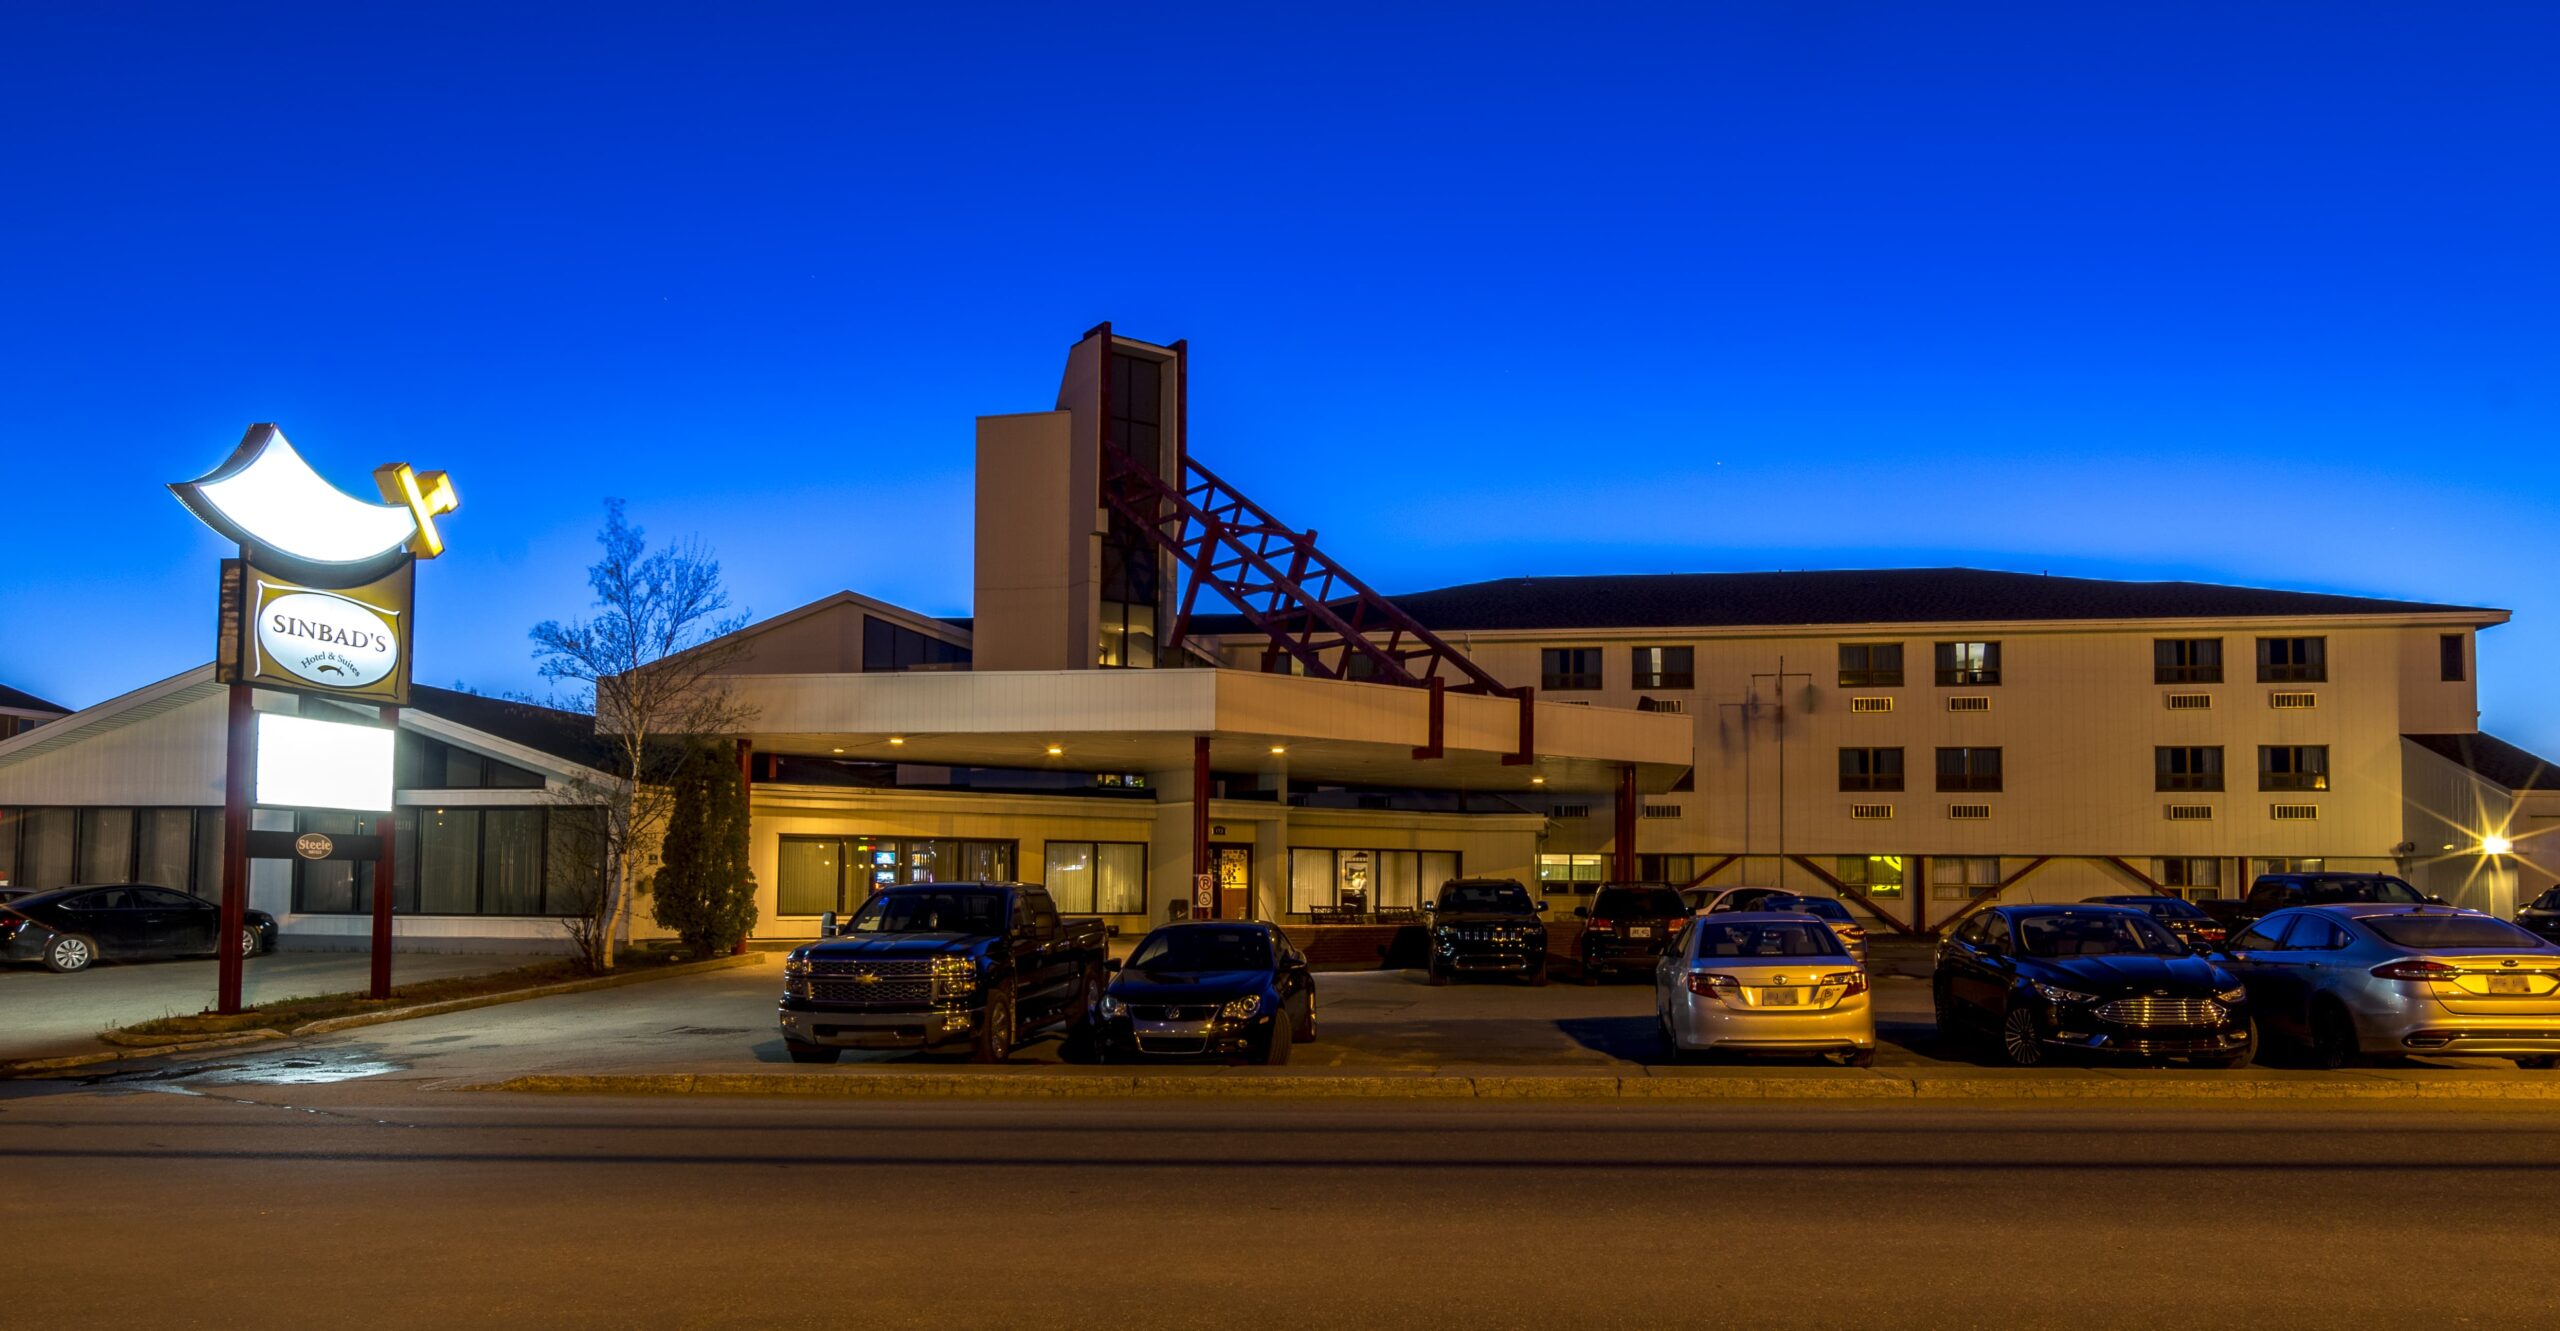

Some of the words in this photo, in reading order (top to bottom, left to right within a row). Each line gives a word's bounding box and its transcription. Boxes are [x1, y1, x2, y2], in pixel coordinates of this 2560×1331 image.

[272, 614, 386, 652] SINBAD'S
[301, 651, 326, 669] Hotel
[328, 652, 336, 661] &
[337, 654, 361, 677] Suites
[298, 839, 331, 850] Steele
